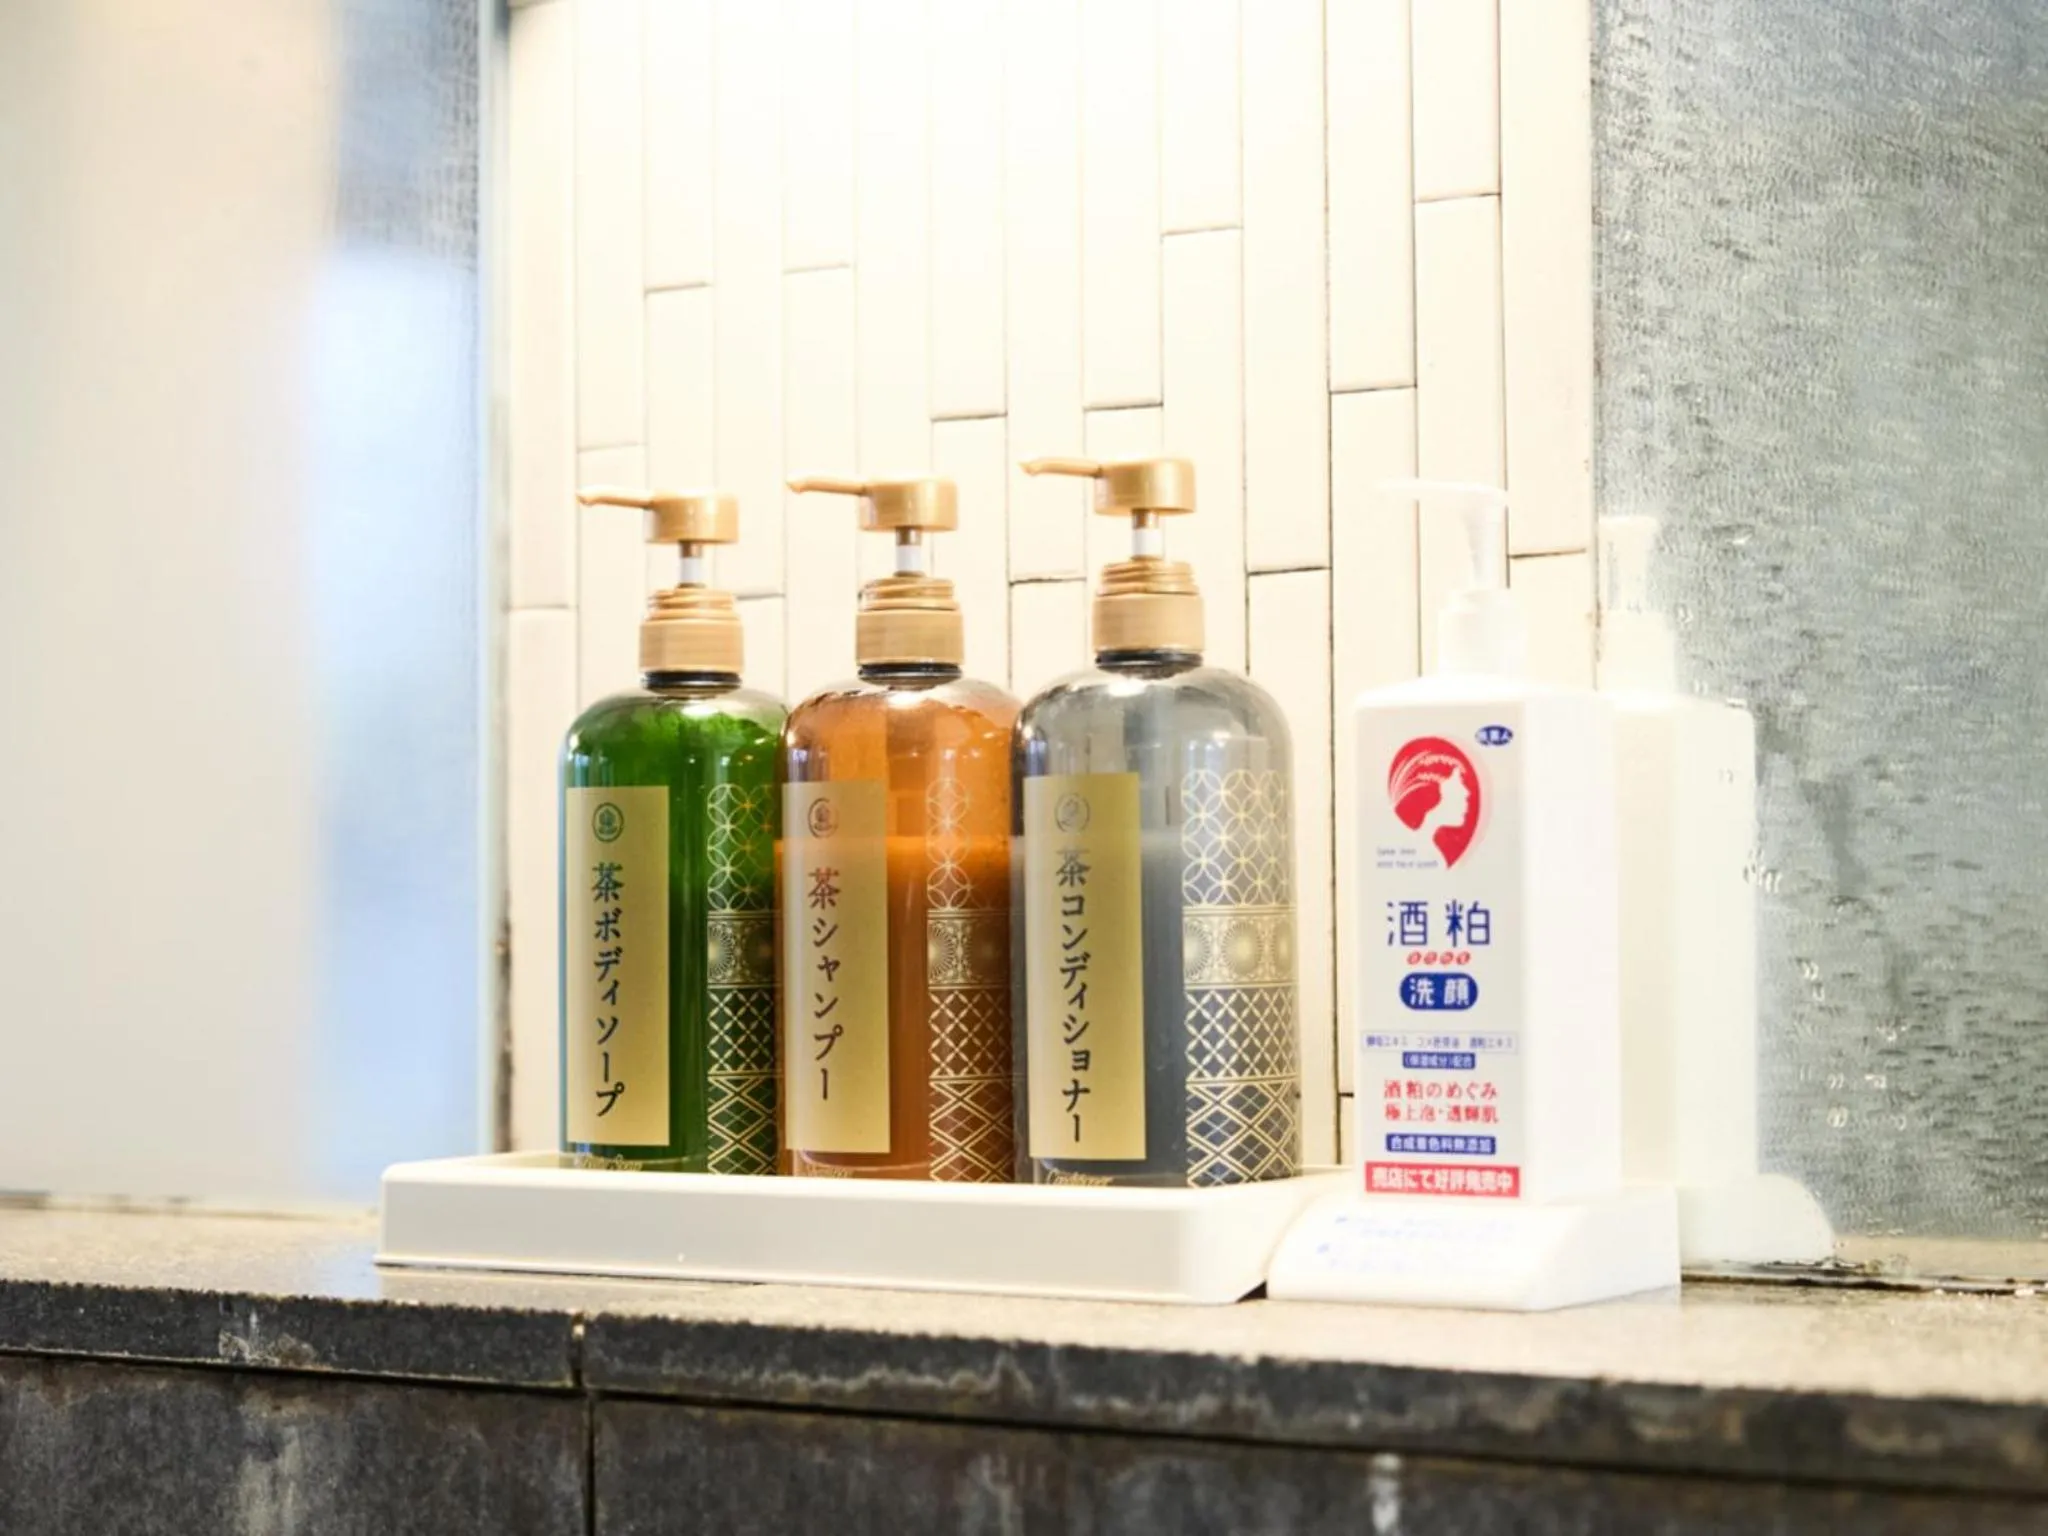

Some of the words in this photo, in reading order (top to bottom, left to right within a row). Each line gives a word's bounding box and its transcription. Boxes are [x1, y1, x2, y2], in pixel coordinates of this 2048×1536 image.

[591, 861, 625, 1118] 茶ボディソープ
[807, 867, 844, 1101] 茶シャンプー
[1386, 900, 1491, 948] 酒粕
[1409, 978, 1470, 1006] 洗顔
[1055, 848, 1092, 1144] 茶コンディショナー
[1384, 1080, 1498, 1100] 酒粕のめぐみ
